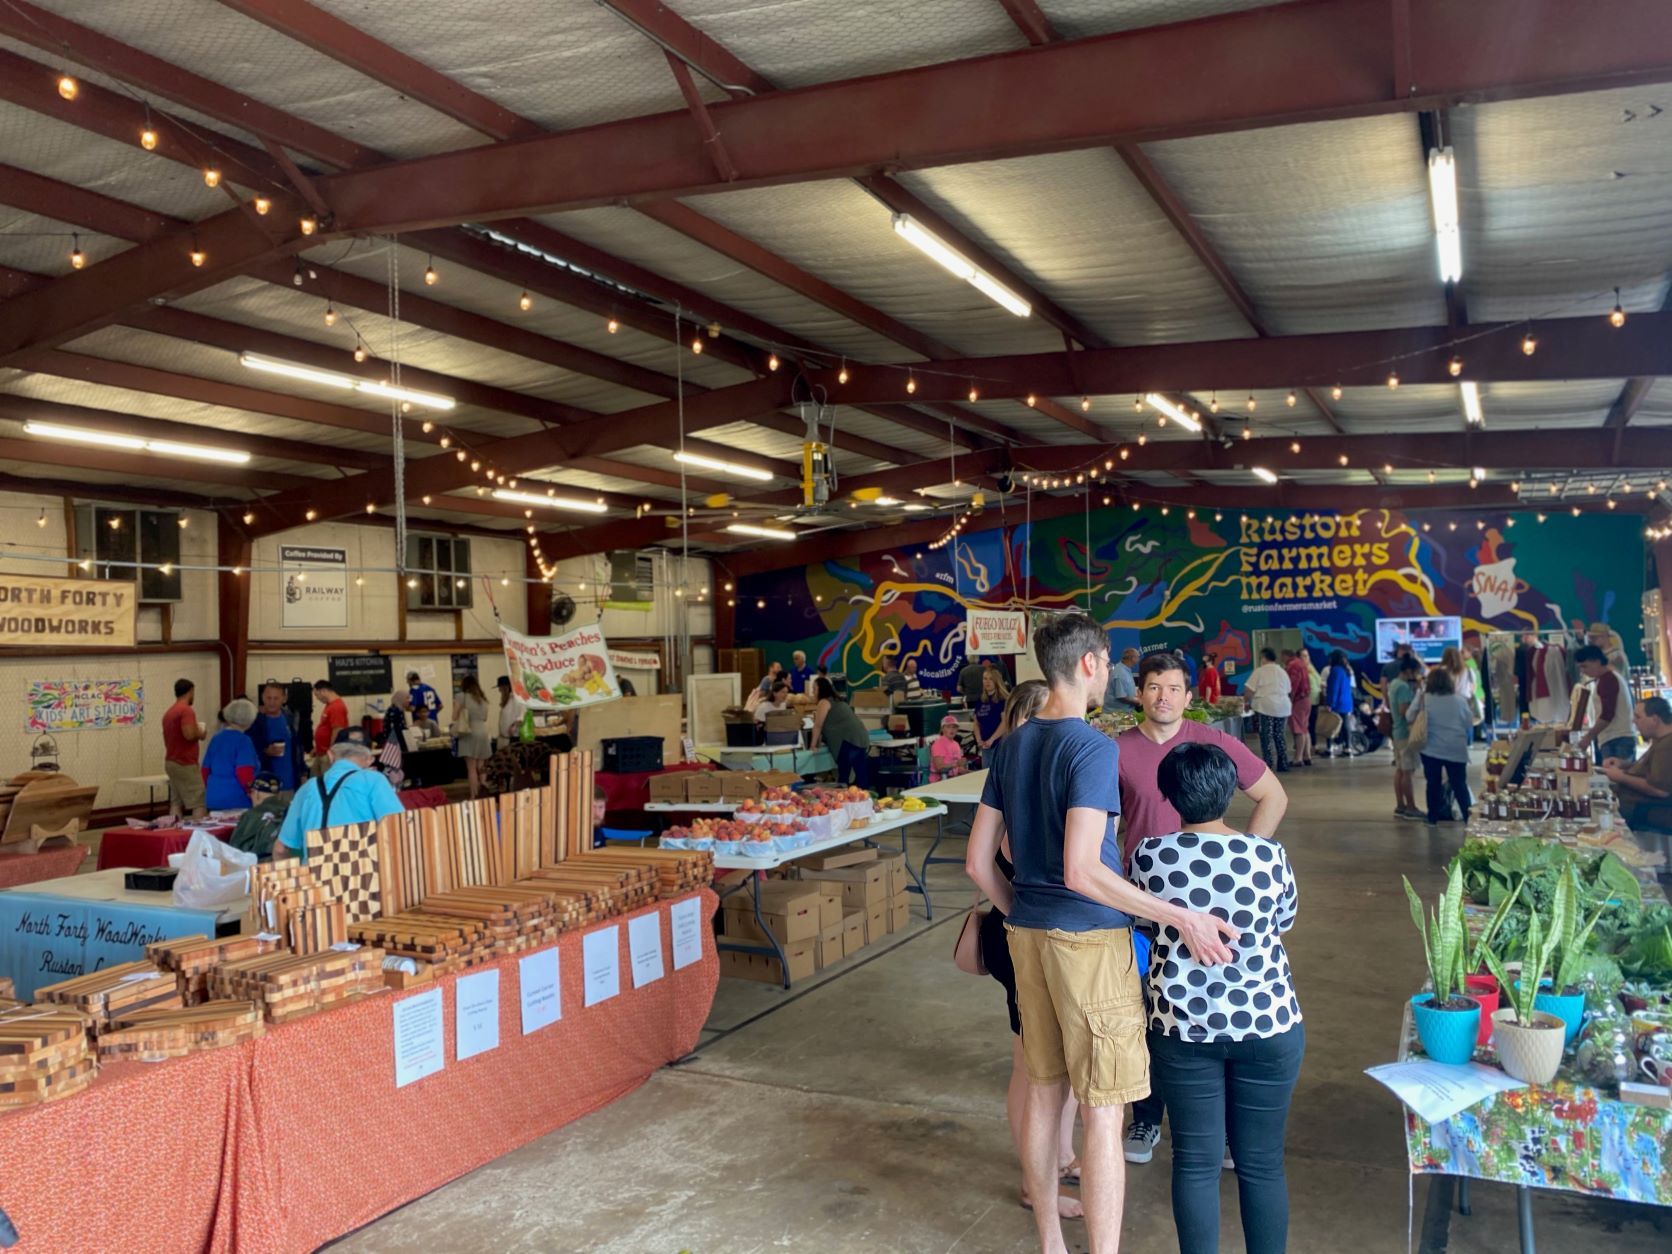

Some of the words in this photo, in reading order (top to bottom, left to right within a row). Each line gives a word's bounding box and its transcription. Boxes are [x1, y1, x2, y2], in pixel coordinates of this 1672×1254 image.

[1240, 513, 1359, 543] Ruston
[307, 551, 333, 559] Provided
[1240, 543, 1389, 572] Farmers
[305, 586, 344, 594] RAILWAY
[1240, 568, 1368, 600] market
[1464, 571, 1530, 602] SNAP
[0, 586, 51, 604] ORTH
[60, 590, 124, 607] FORTY
[1241, 600, 1337, 612] @rustonfarmersmarket
[975, 617, 996, 630] FUEGO
[548, 632, 600, 653] Peaches
[919, 655, 962, 678] #localflavors
[423, 691, 436, 710] 12
[70, 708, 89, 721] ART
[93, 702, 136, 719] STATION
[15, 912, 50, 935] North
[54, 914, 87, 946] Forty
